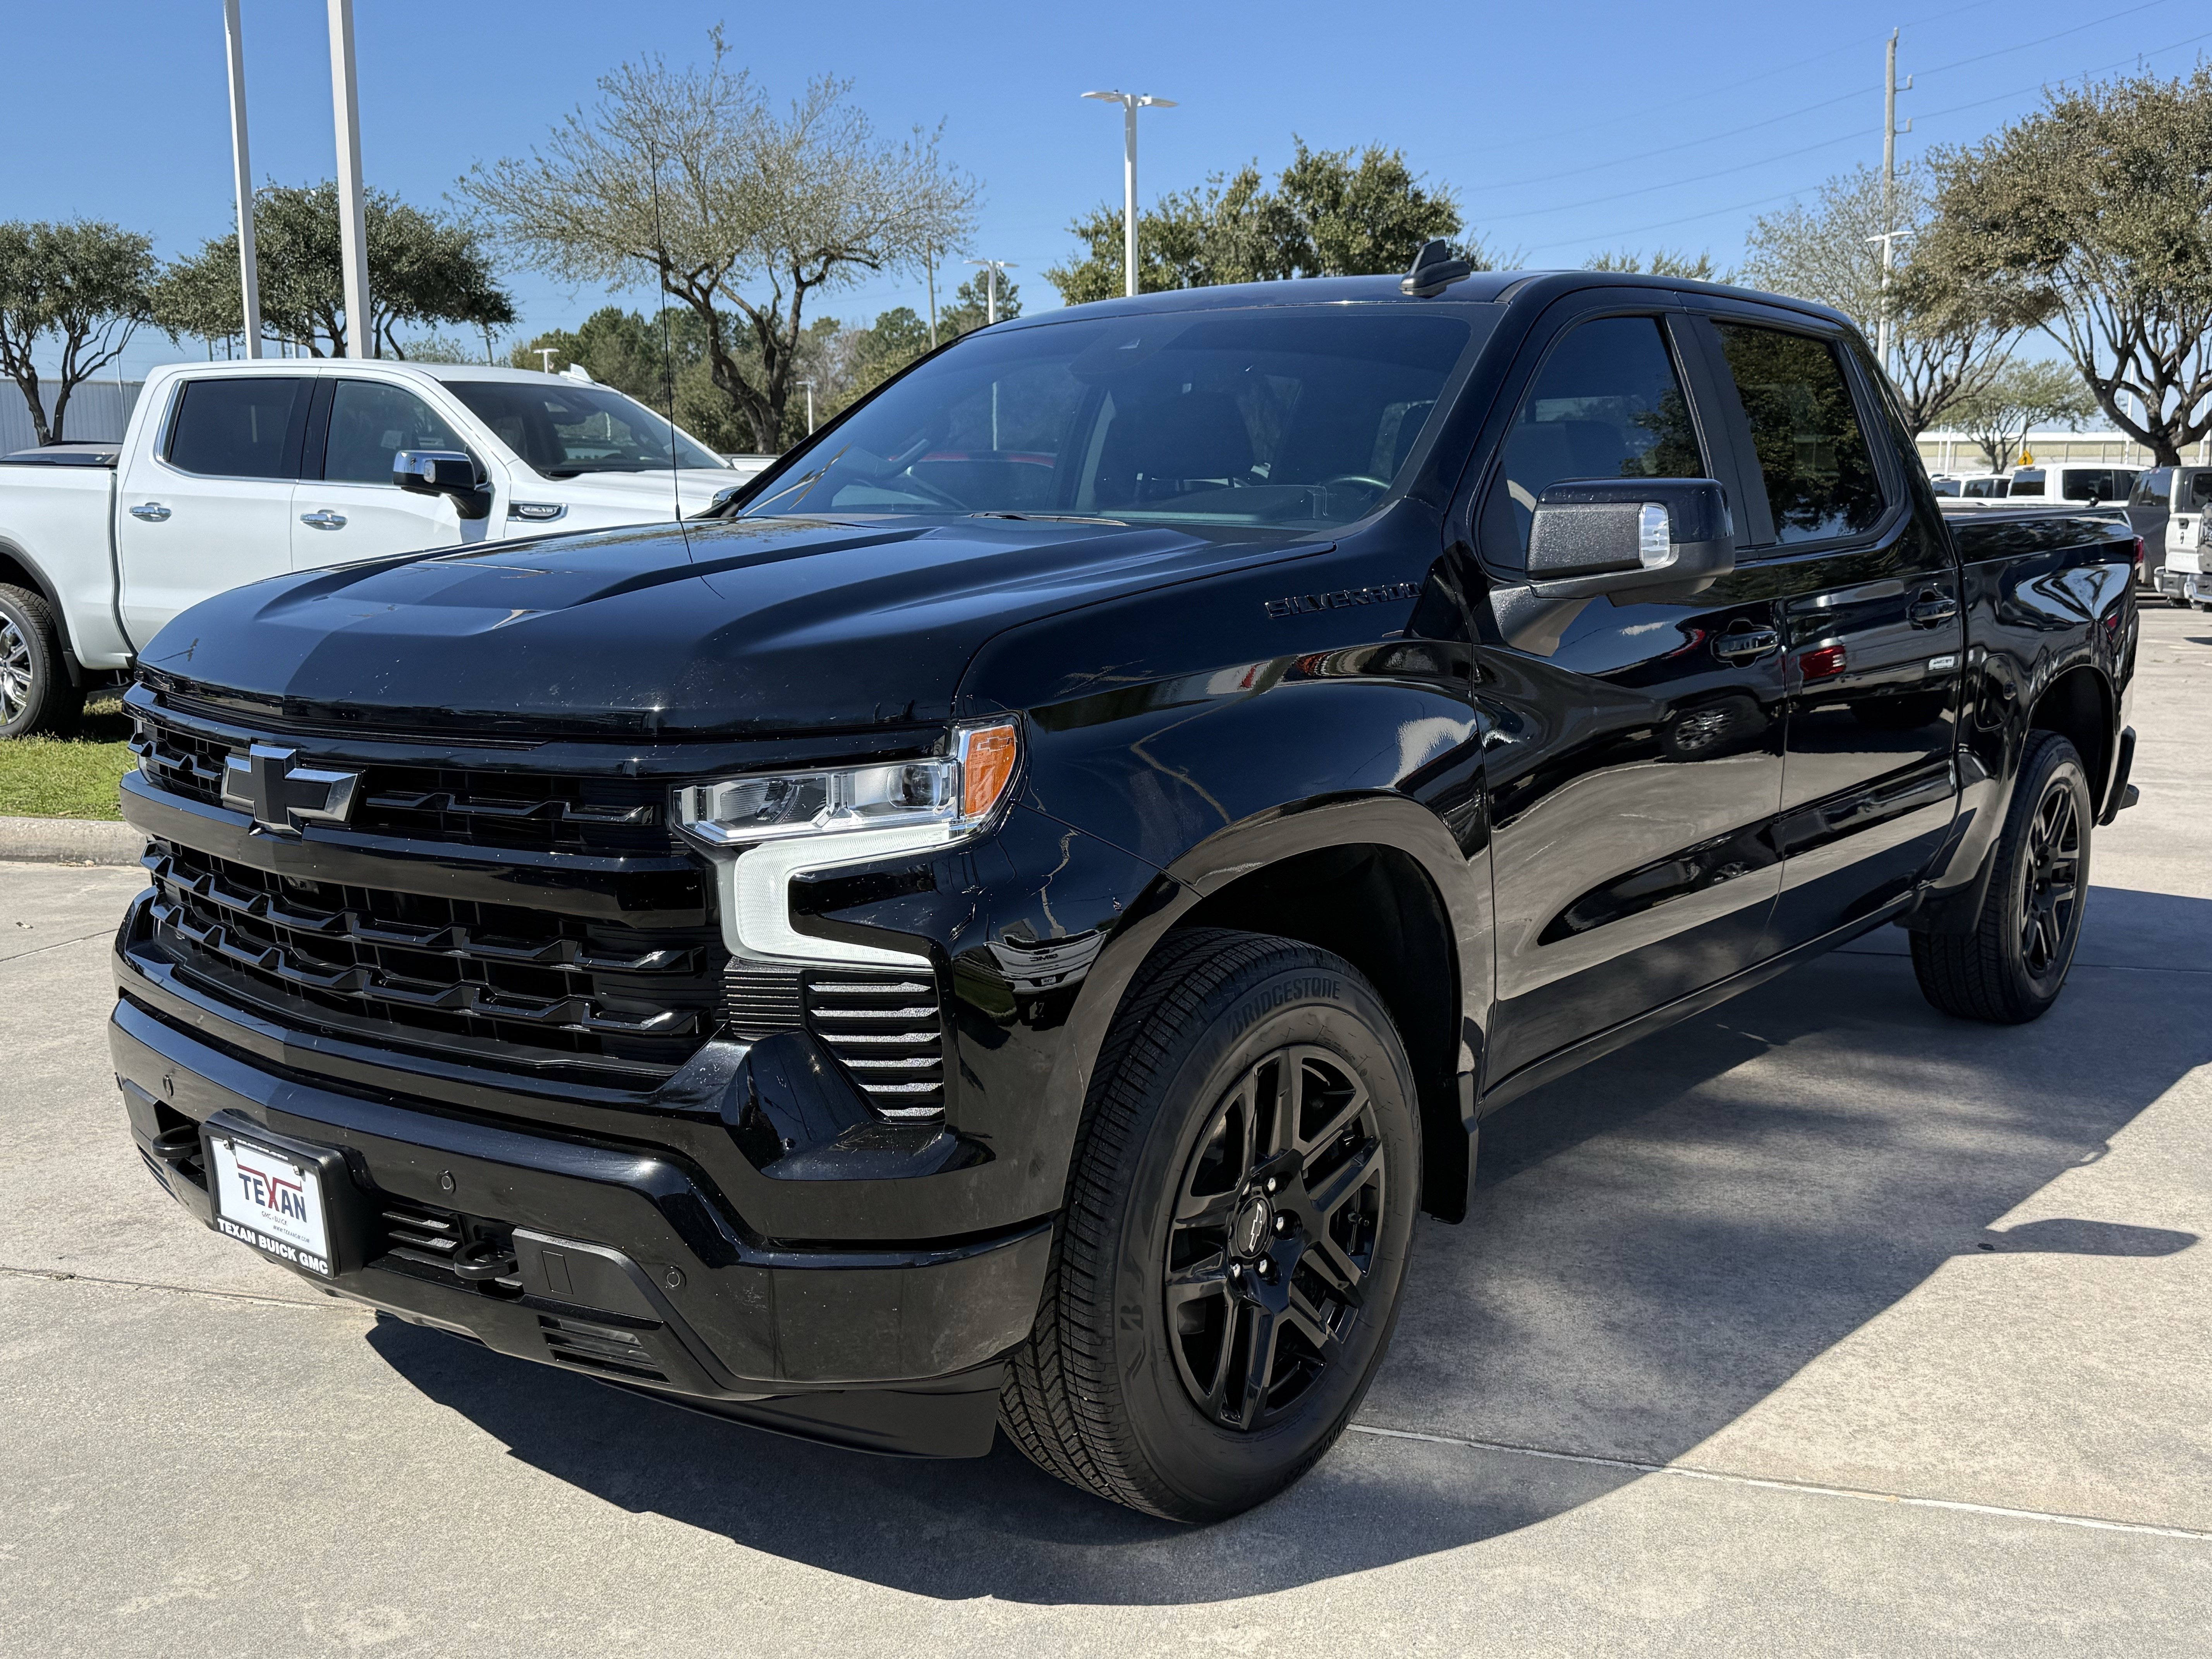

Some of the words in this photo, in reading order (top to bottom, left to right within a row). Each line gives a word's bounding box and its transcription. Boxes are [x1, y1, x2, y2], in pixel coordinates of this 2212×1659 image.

[1265, 581, 1422, 618] SILVERADO
[1229, 977, 1341, 1042] BRIDGESTONE
[237, 1164, 307, 1223] TEXAN
[217, 1218, 256, 1245] TEXAN
[258, 1236, 297, 1262] BUICK
[299, 1251, 328, 1275] GMC
